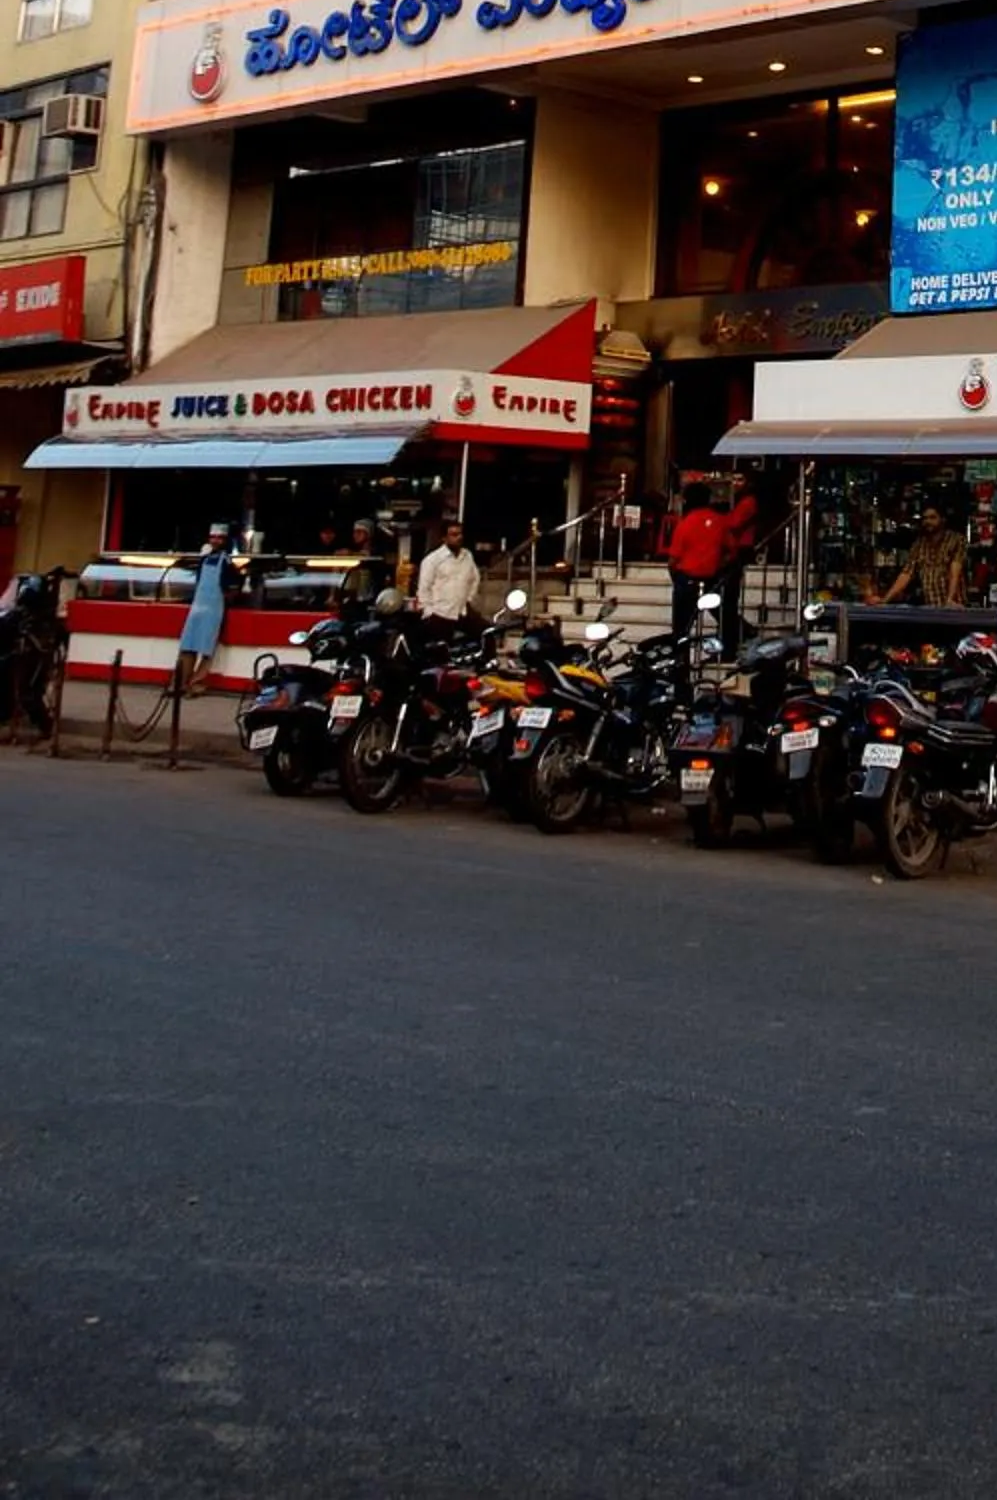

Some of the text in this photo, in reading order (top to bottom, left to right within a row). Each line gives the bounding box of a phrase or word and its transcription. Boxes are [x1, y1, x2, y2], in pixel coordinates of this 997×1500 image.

[945, 188, 994, 209] ONLY
[917, 215, 947, 233] NON
[950, 212, 978, 228] VEG
[275, 260, 322, 284] PARTY
[911, 275, 949, 291] HOME
[909, 289, 935, 305] GET
[937, 288, 948, 303] A
[951, 286, 990, 302] PEPSI
[88, 394, 161, 428] EMPIRE
[171, 395, 231, 418] JUICE
[252, 389, 316, 417] DOSA
[325, 384, 433, 413] CHICKEN
[491, 385, 578, 423] EMPIRE
